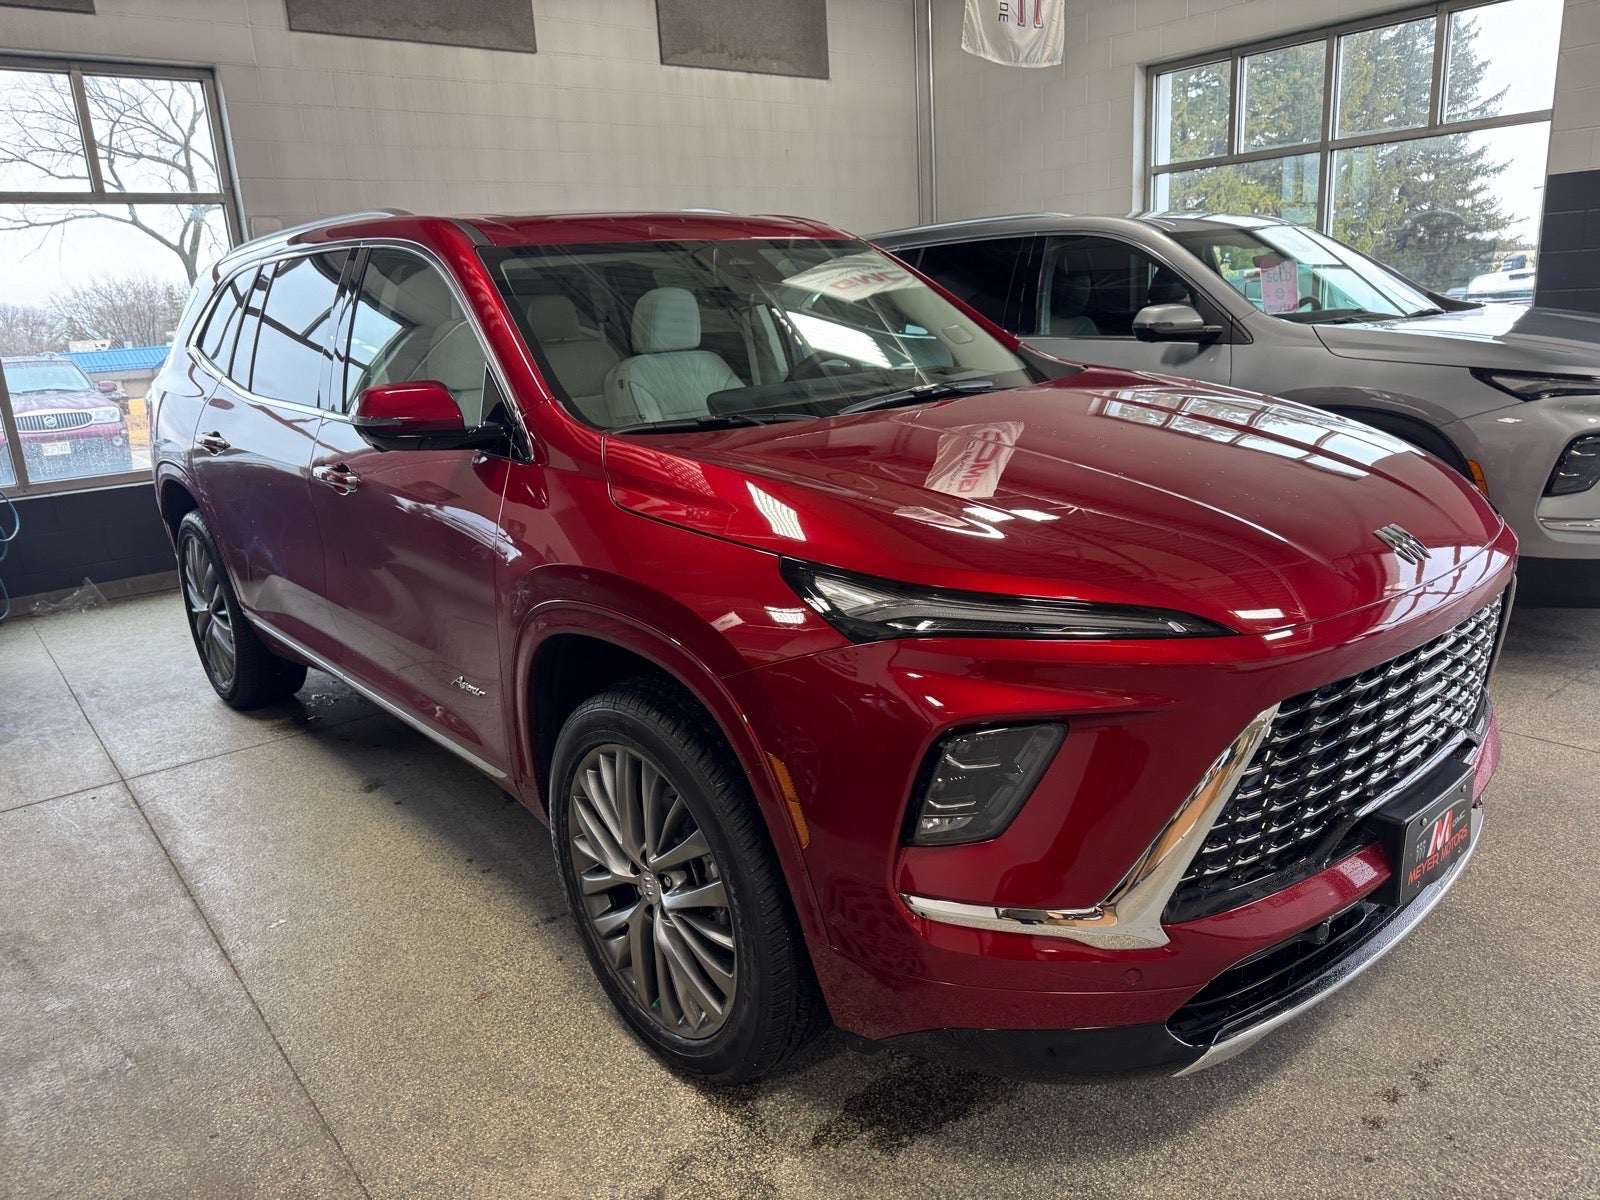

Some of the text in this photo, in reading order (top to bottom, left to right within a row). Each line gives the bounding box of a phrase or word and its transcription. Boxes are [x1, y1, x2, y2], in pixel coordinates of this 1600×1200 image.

[1265, 271, 1293, 284] SOLD
[1407, 822, 1469, 886] MEYER MOTORS
[1426, 808, 1454, 858] M
